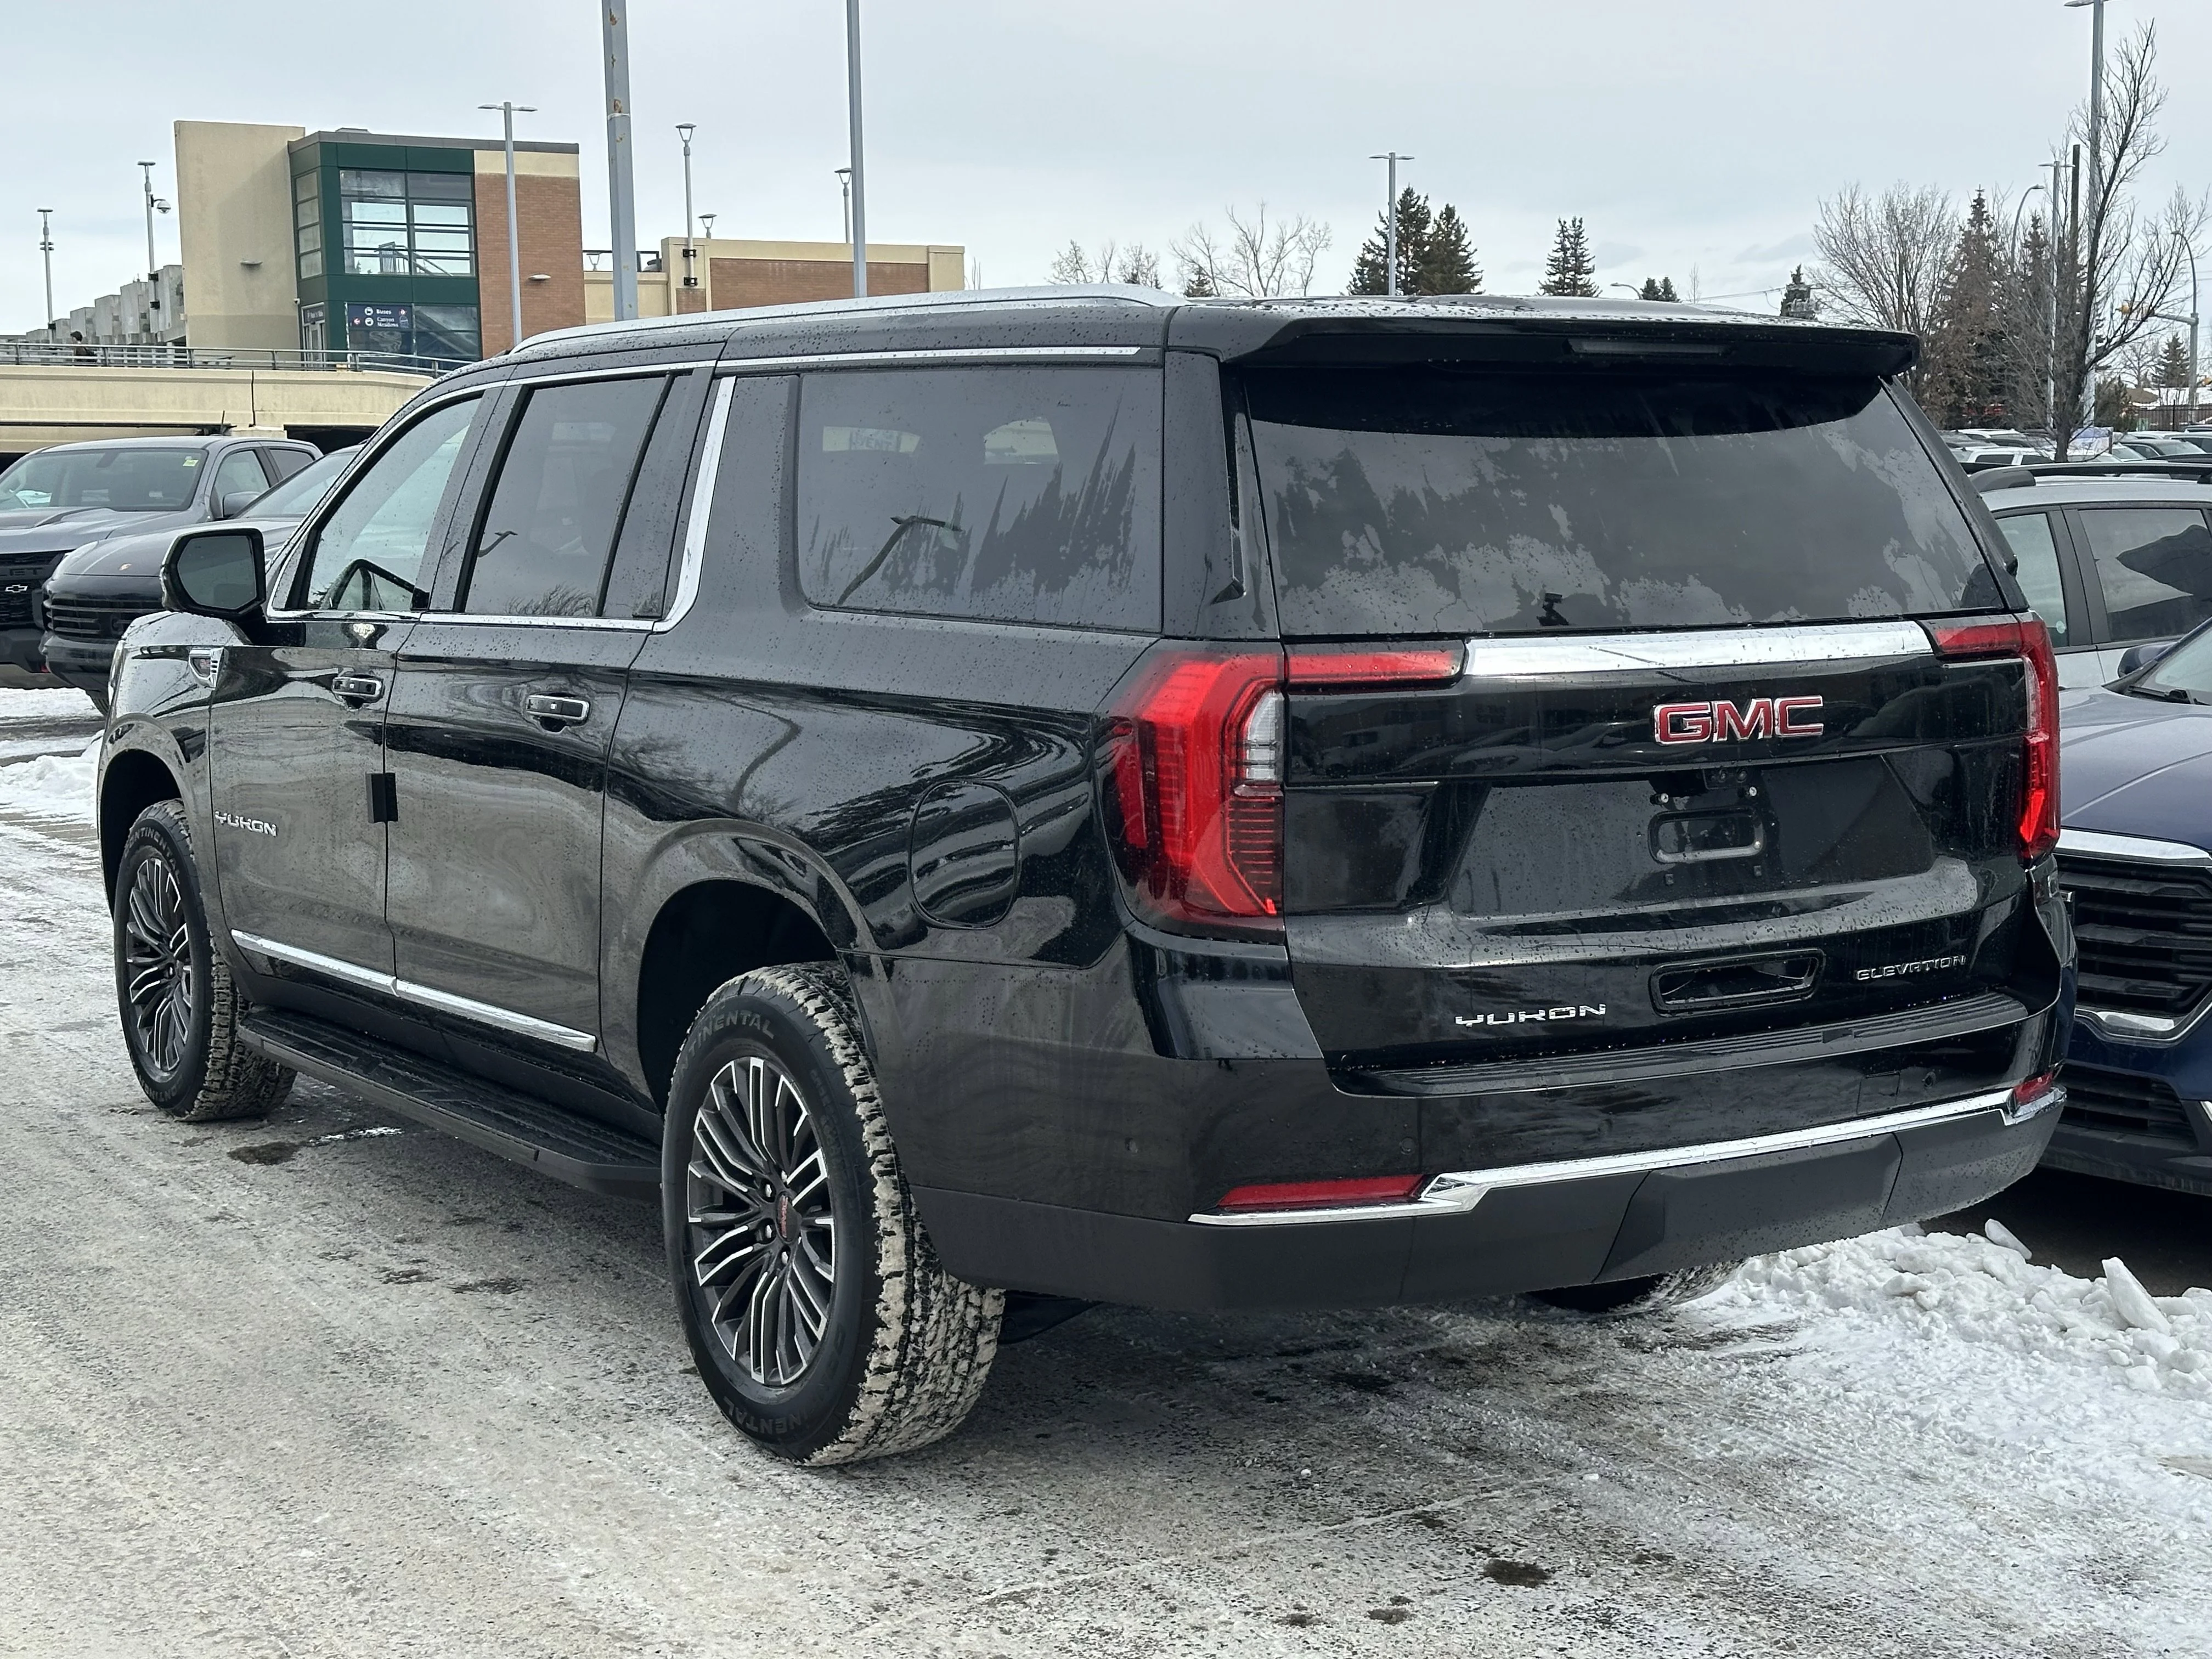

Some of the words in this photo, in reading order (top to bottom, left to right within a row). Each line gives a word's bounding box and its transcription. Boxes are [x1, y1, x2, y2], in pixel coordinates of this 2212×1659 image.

[1654, 695, 1824, 746] GMC
[215, 810, 277, 837] YUKON
[1855, 955, 1966, 980] ELEVATION
[1455, 1003, 1606, 1027] YUKON
